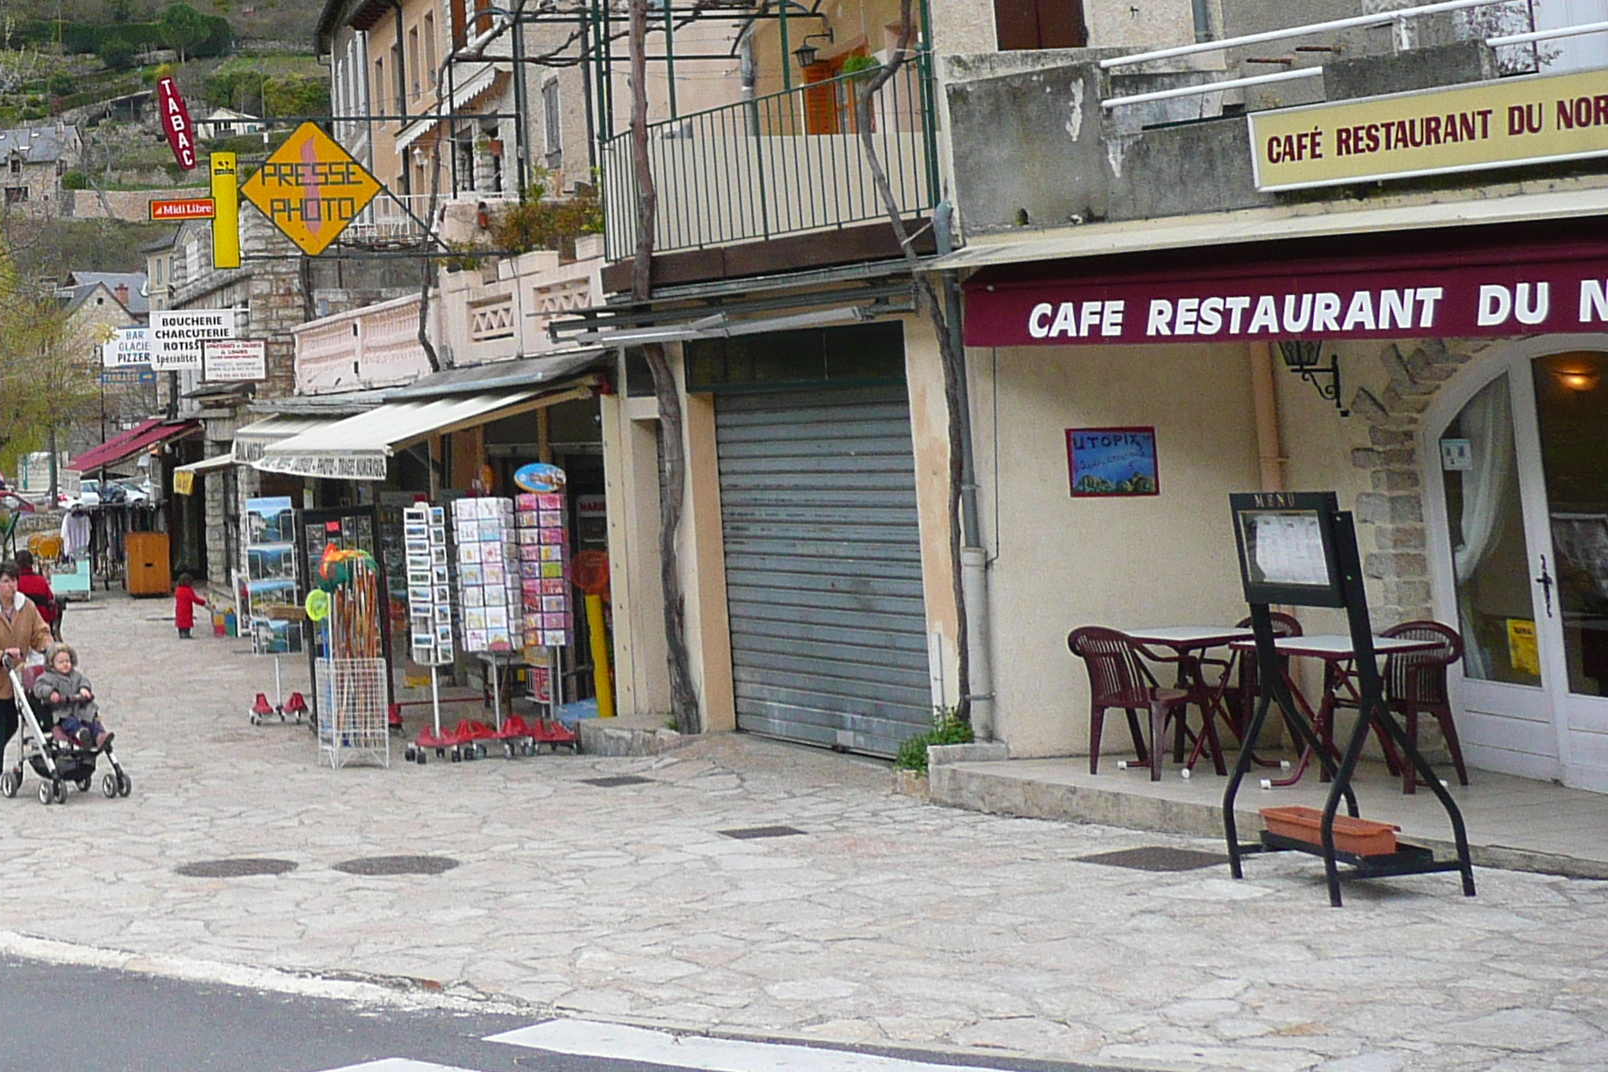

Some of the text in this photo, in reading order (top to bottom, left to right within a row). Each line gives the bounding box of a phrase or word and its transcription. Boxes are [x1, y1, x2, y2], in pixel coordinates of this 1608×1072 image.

[161, 79, 193, 166] TABAC
[1267, 125, 1323, 164] CAFÉ
[1336, 109, 1493, 156] RESTAURANT
[1507, 103, 1543, 136] DU
[261, 162, 363, 186] PRESSE
[163, 203, 212, 215] Midi Libre
[270, 197, 354, 222] PHOTO
[1028, 300, 1125, 338] CAFE
[1146, 287, 1443, 336] RESTAURANT
[1477, 282, 1549, 326] DU
[162, 316, 222, 327] BOUCHERIE
[125, 330, 144, 340] BAR
[155, 328, 229, 339] CHARCUTERIE
[117, 352, 151, 363] PIZZER
[1254, 494, 1295, 507] MENU
